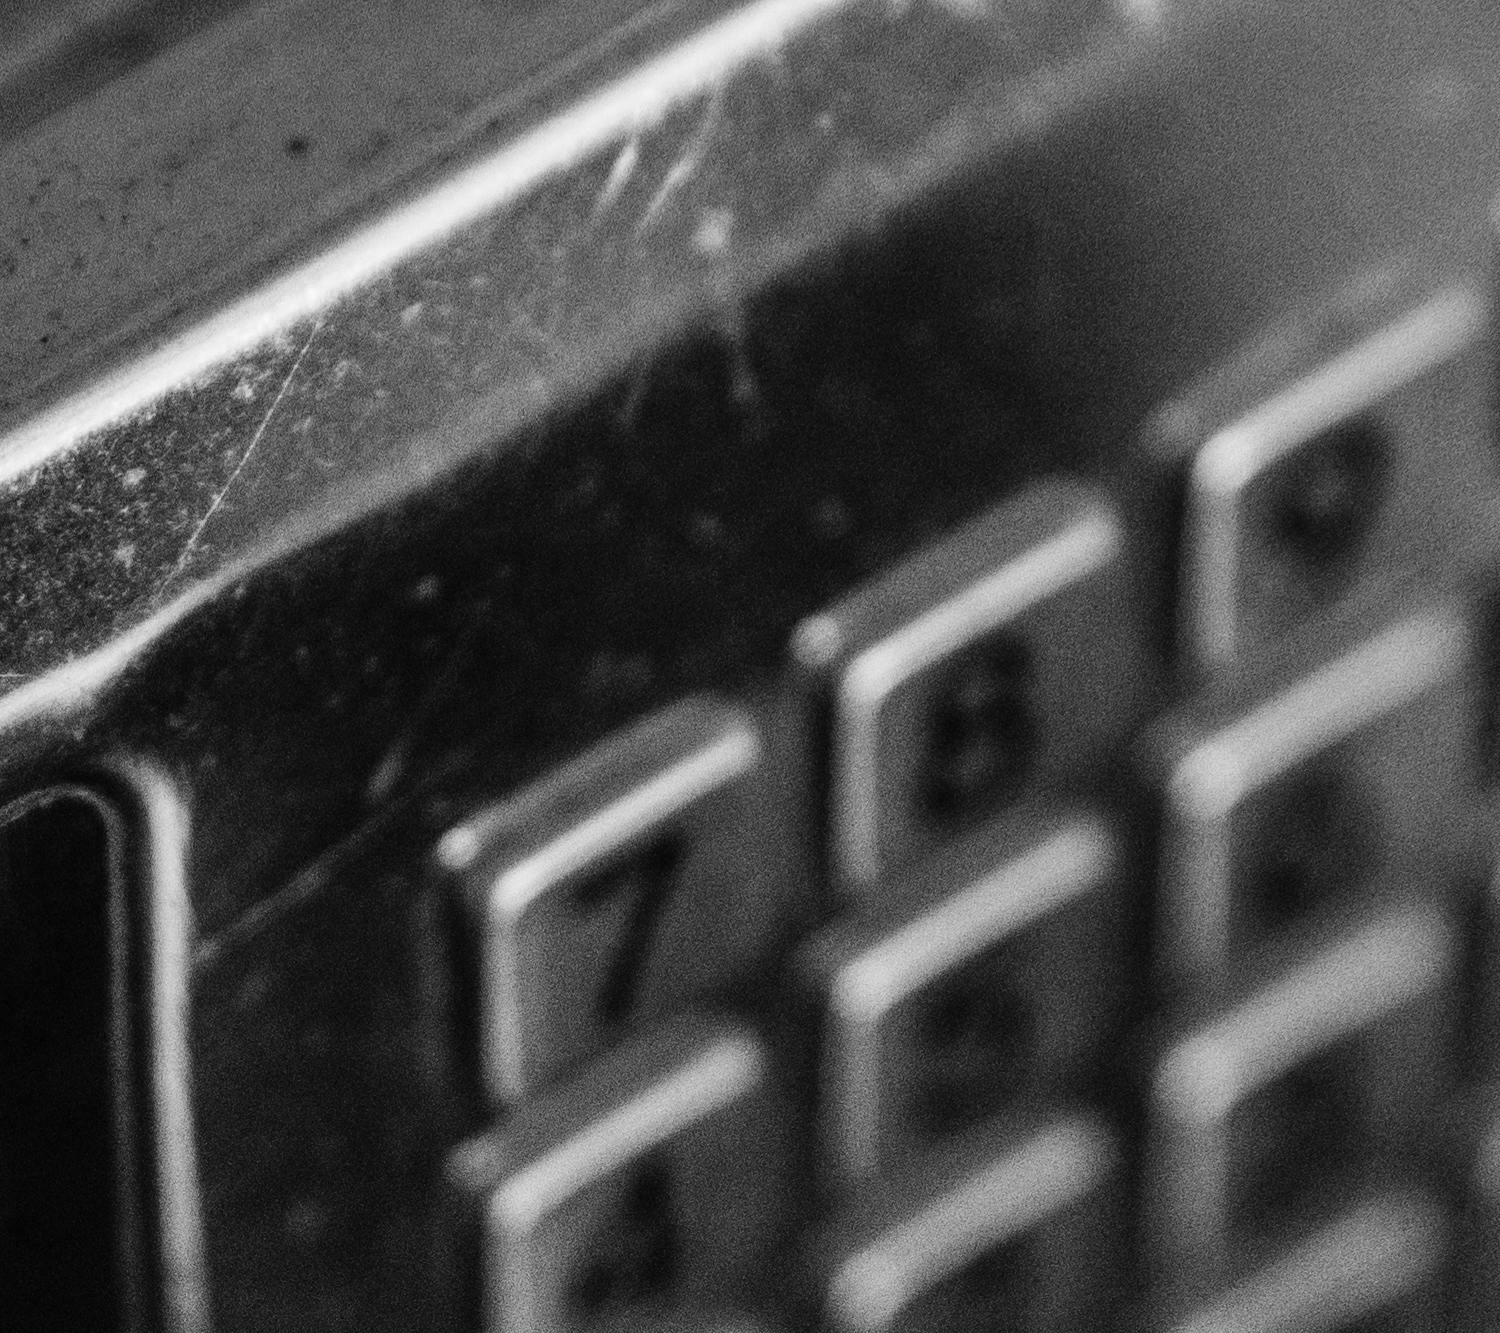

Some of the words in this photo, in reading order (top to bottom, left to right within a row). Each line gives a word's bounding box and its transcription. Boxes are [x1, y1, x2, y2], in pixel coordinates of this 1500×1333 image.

[1262, 410, 1400, 582] 9
[924, 632, 1036, 826] 8
[567, 830, 686, 1028] 7
